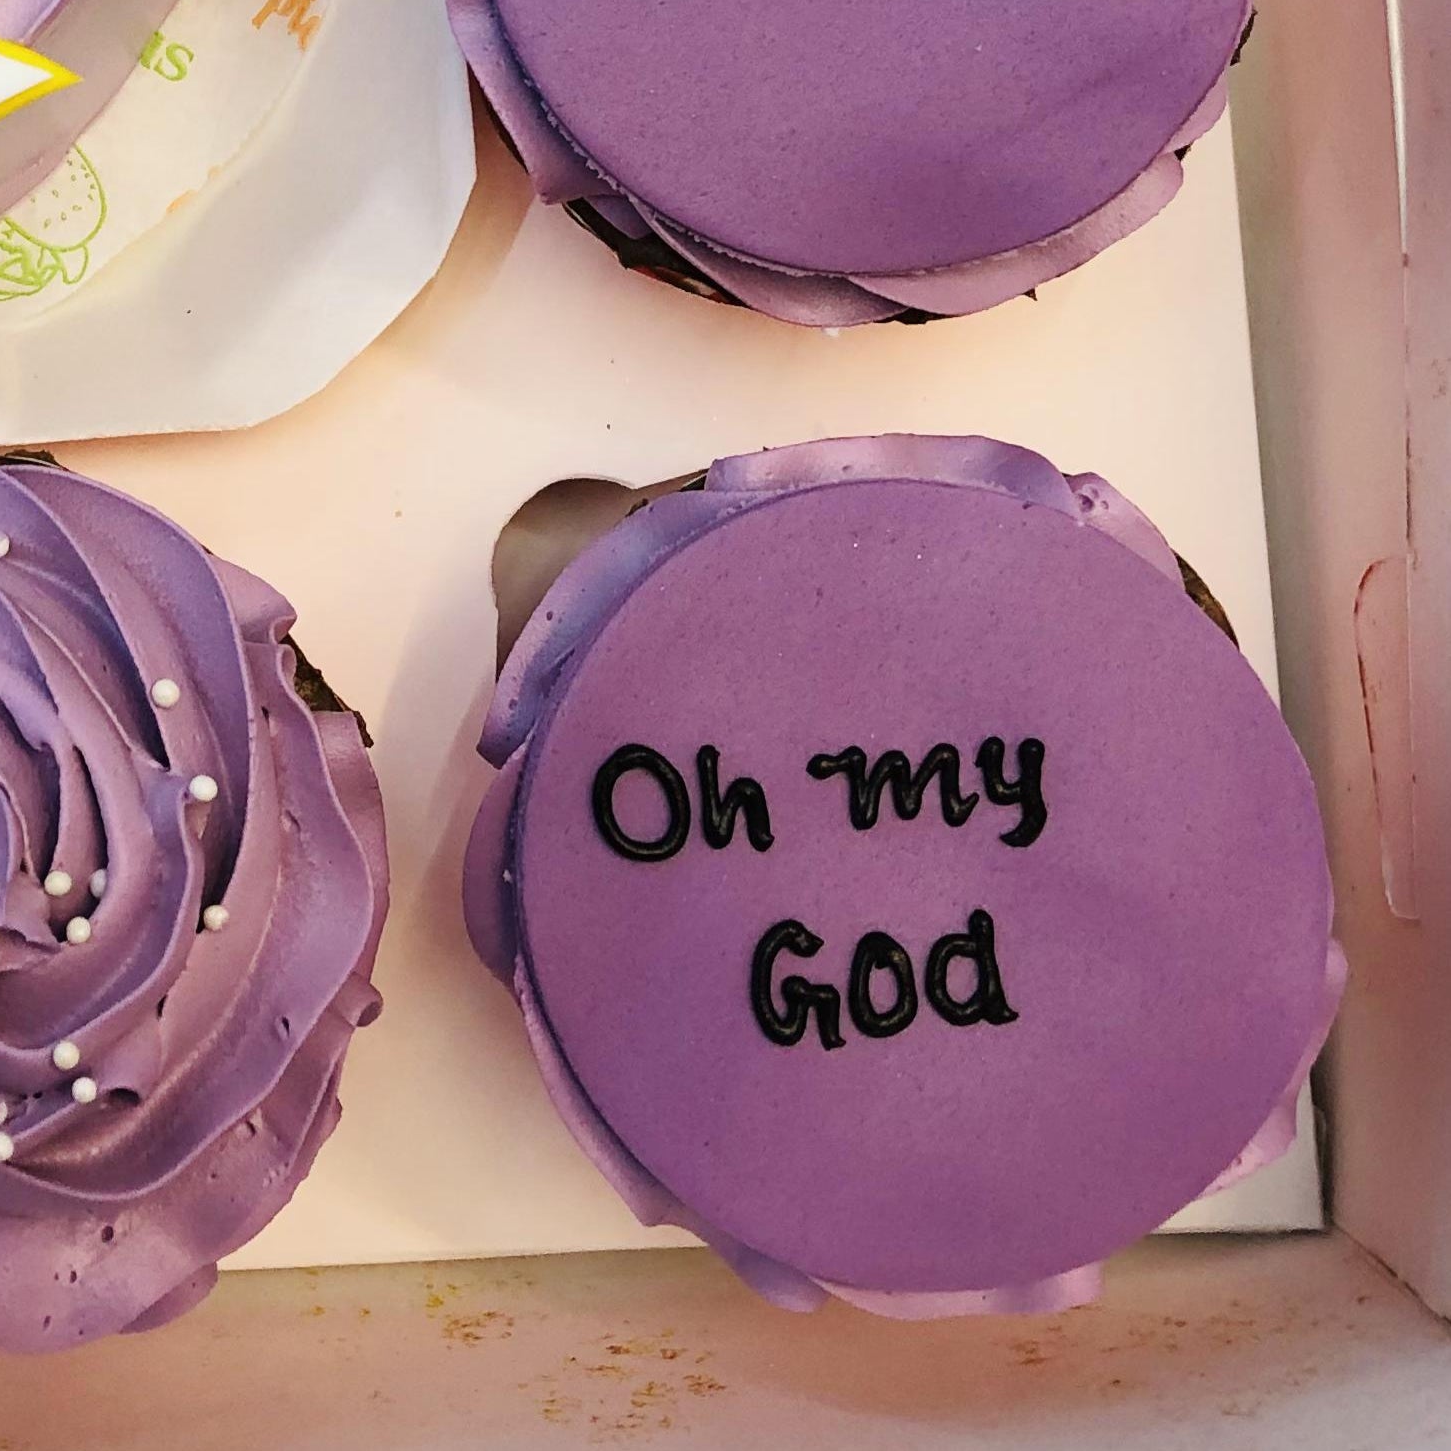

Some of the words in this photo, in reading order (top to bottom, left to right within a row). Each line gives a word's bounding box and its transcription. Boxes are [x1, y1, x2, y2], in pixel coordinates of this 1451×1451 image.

[592, 743, 774, 862] Oh
[806, 736, 1047, 848] my
[752, 910, 1019, 1050] God
